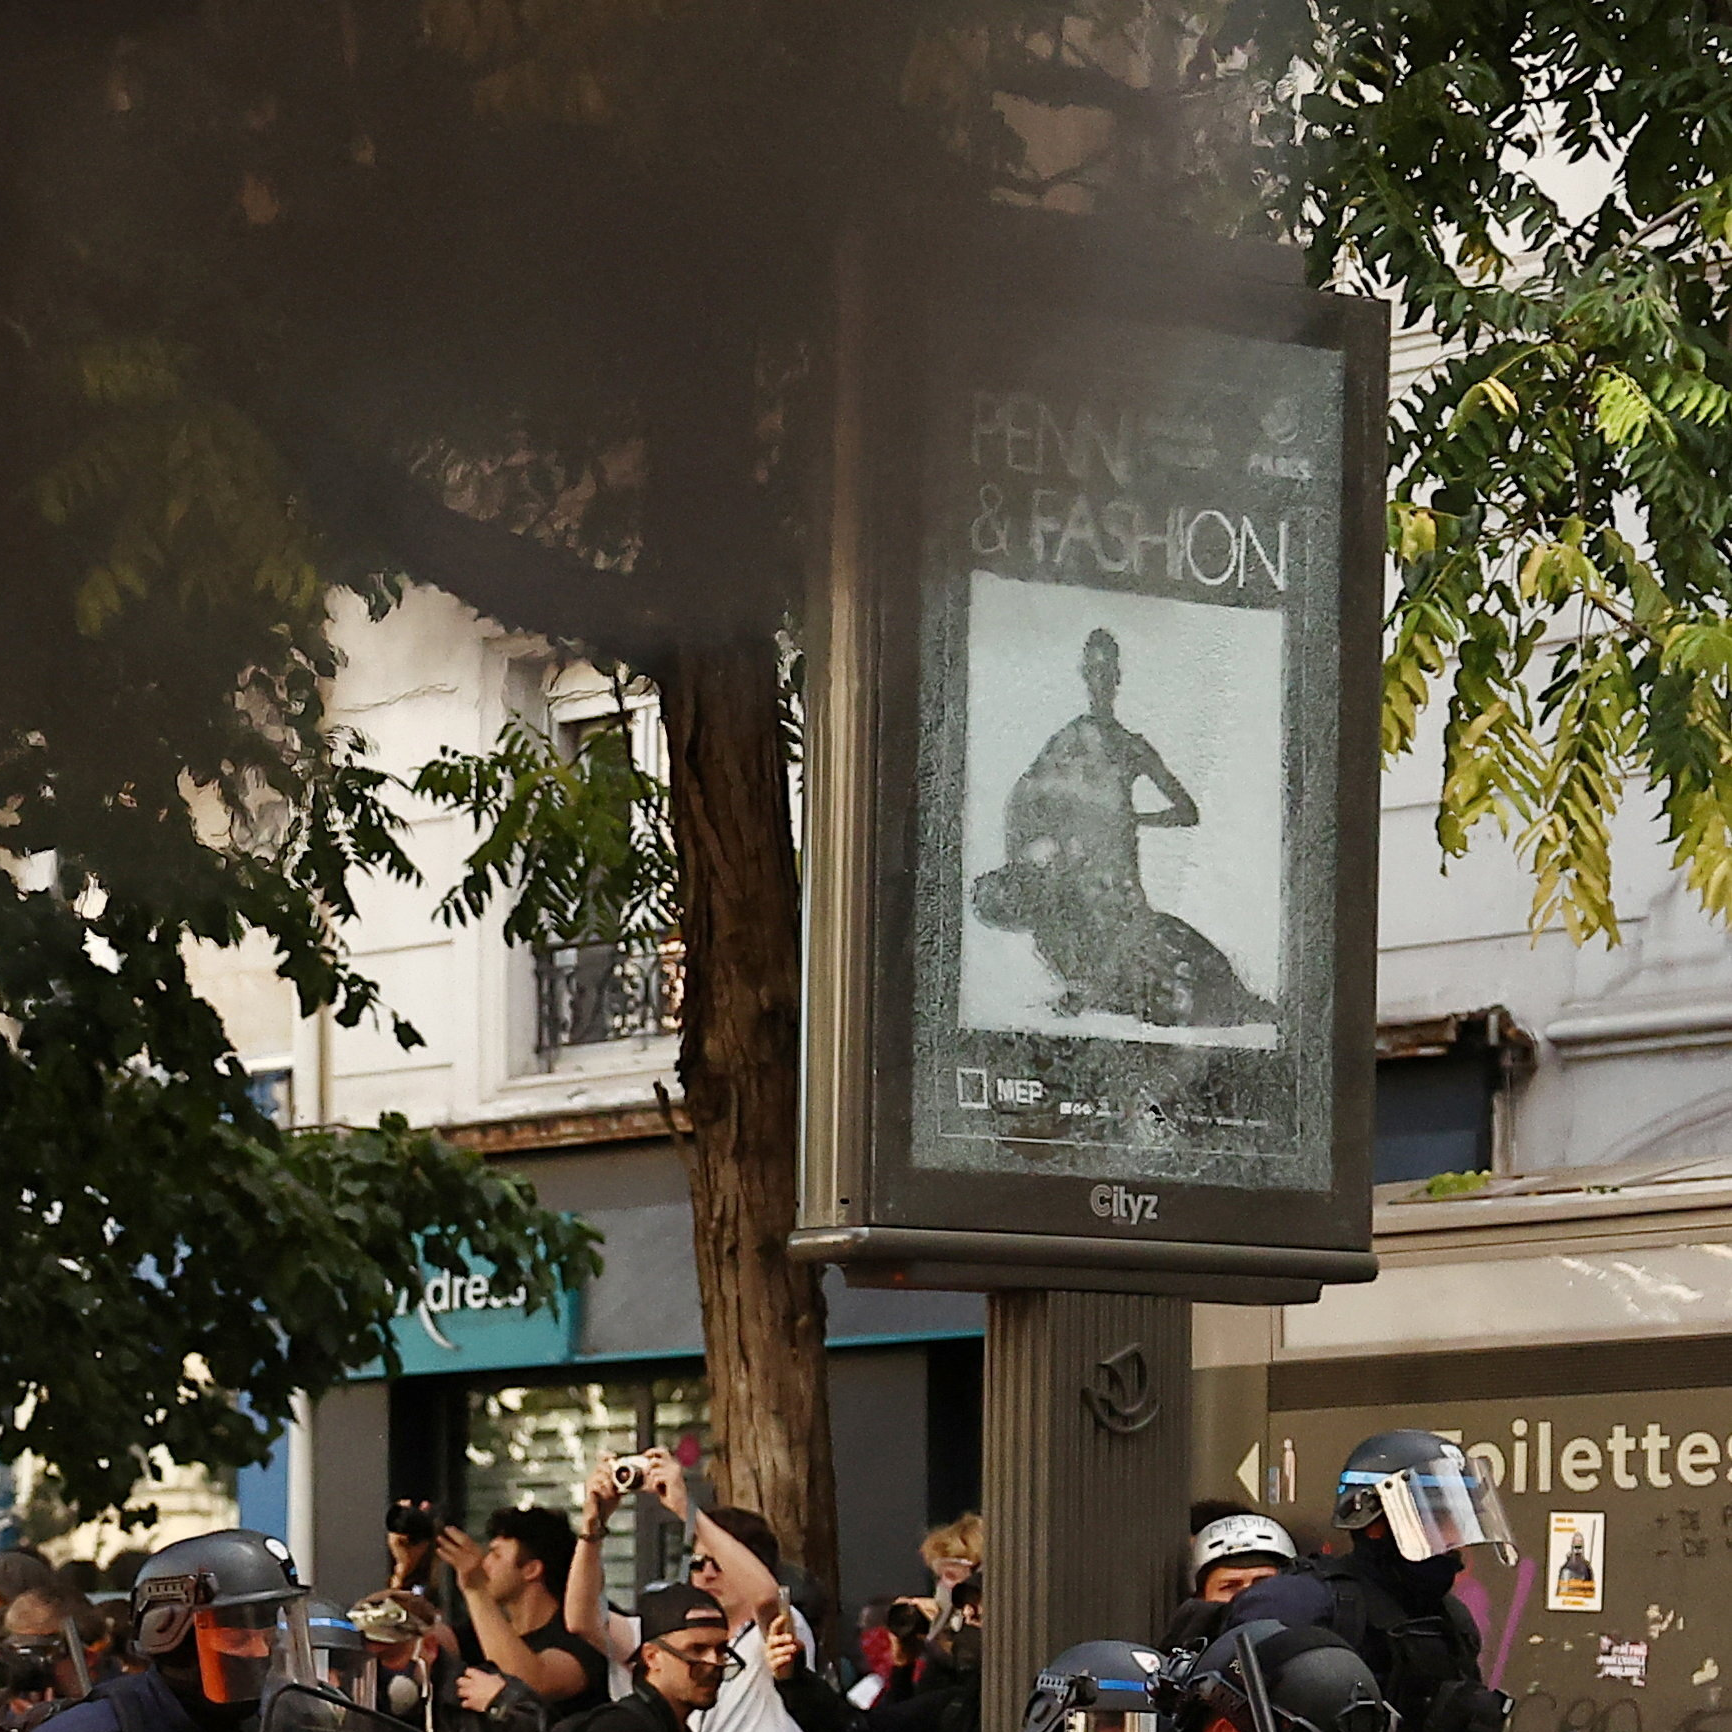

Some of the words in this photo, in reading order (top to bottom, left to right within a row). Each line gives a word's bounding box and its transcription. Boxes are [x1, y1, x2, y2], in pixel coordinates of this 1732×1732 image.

[971, 483, 1010, 555] &
[1030, 486, 1286, 592] FASHION
[1090, 1184, 1159, 1225] Cityz
[1429, 1417, 1732, 1494] oilette
